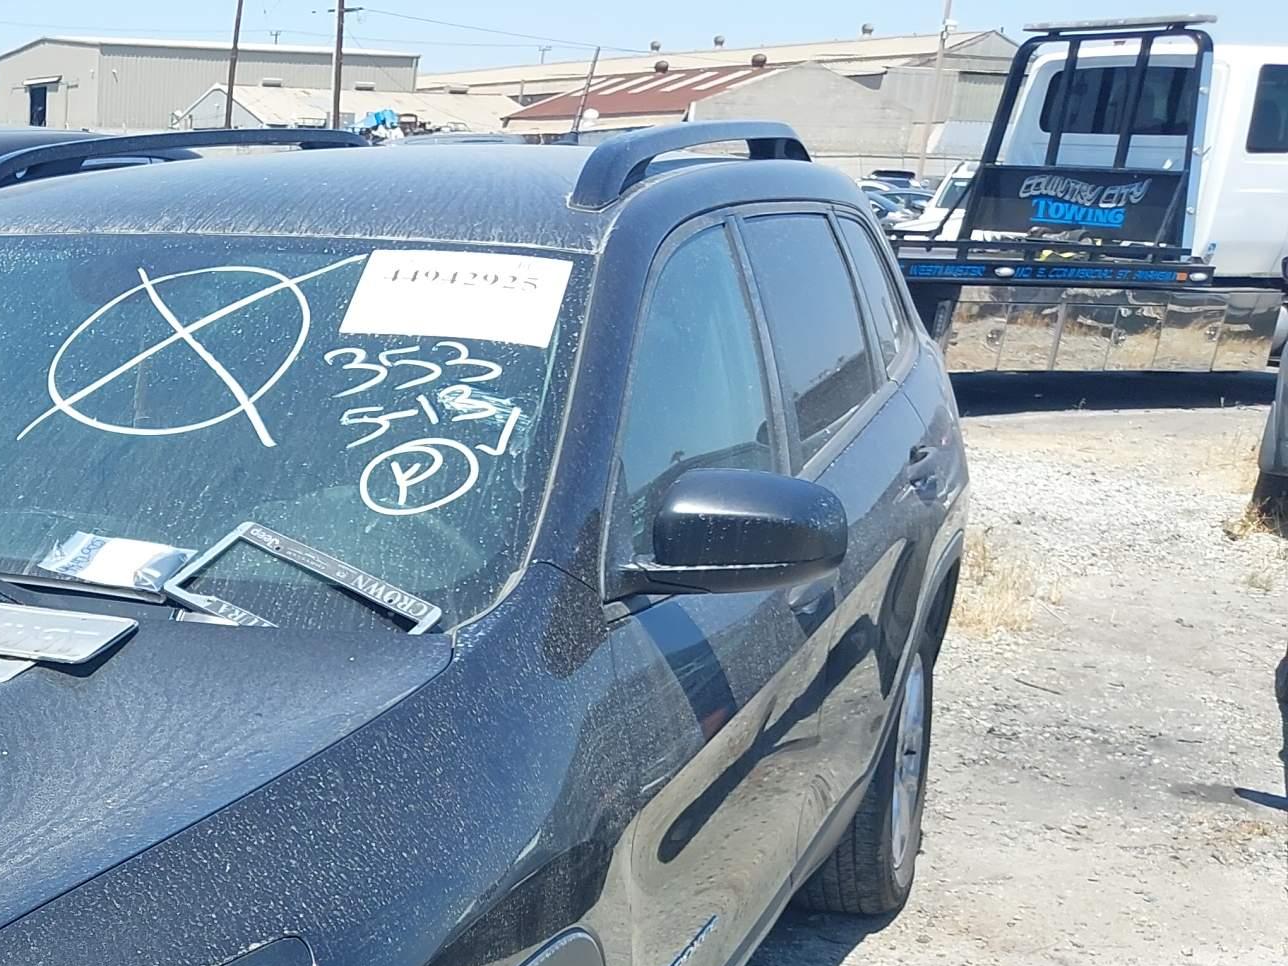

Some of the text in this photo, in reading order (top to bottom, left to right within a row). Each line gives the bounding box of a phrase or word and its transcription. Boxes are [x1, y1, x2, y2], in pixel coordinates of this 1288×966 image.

[1019, 175, 1152, 208] COUNTRY CITY
[1032, 199, 1126, 224] TOWING
[324, 340, 503, 398] 353
[351, 574, 428, 617] CROWN
